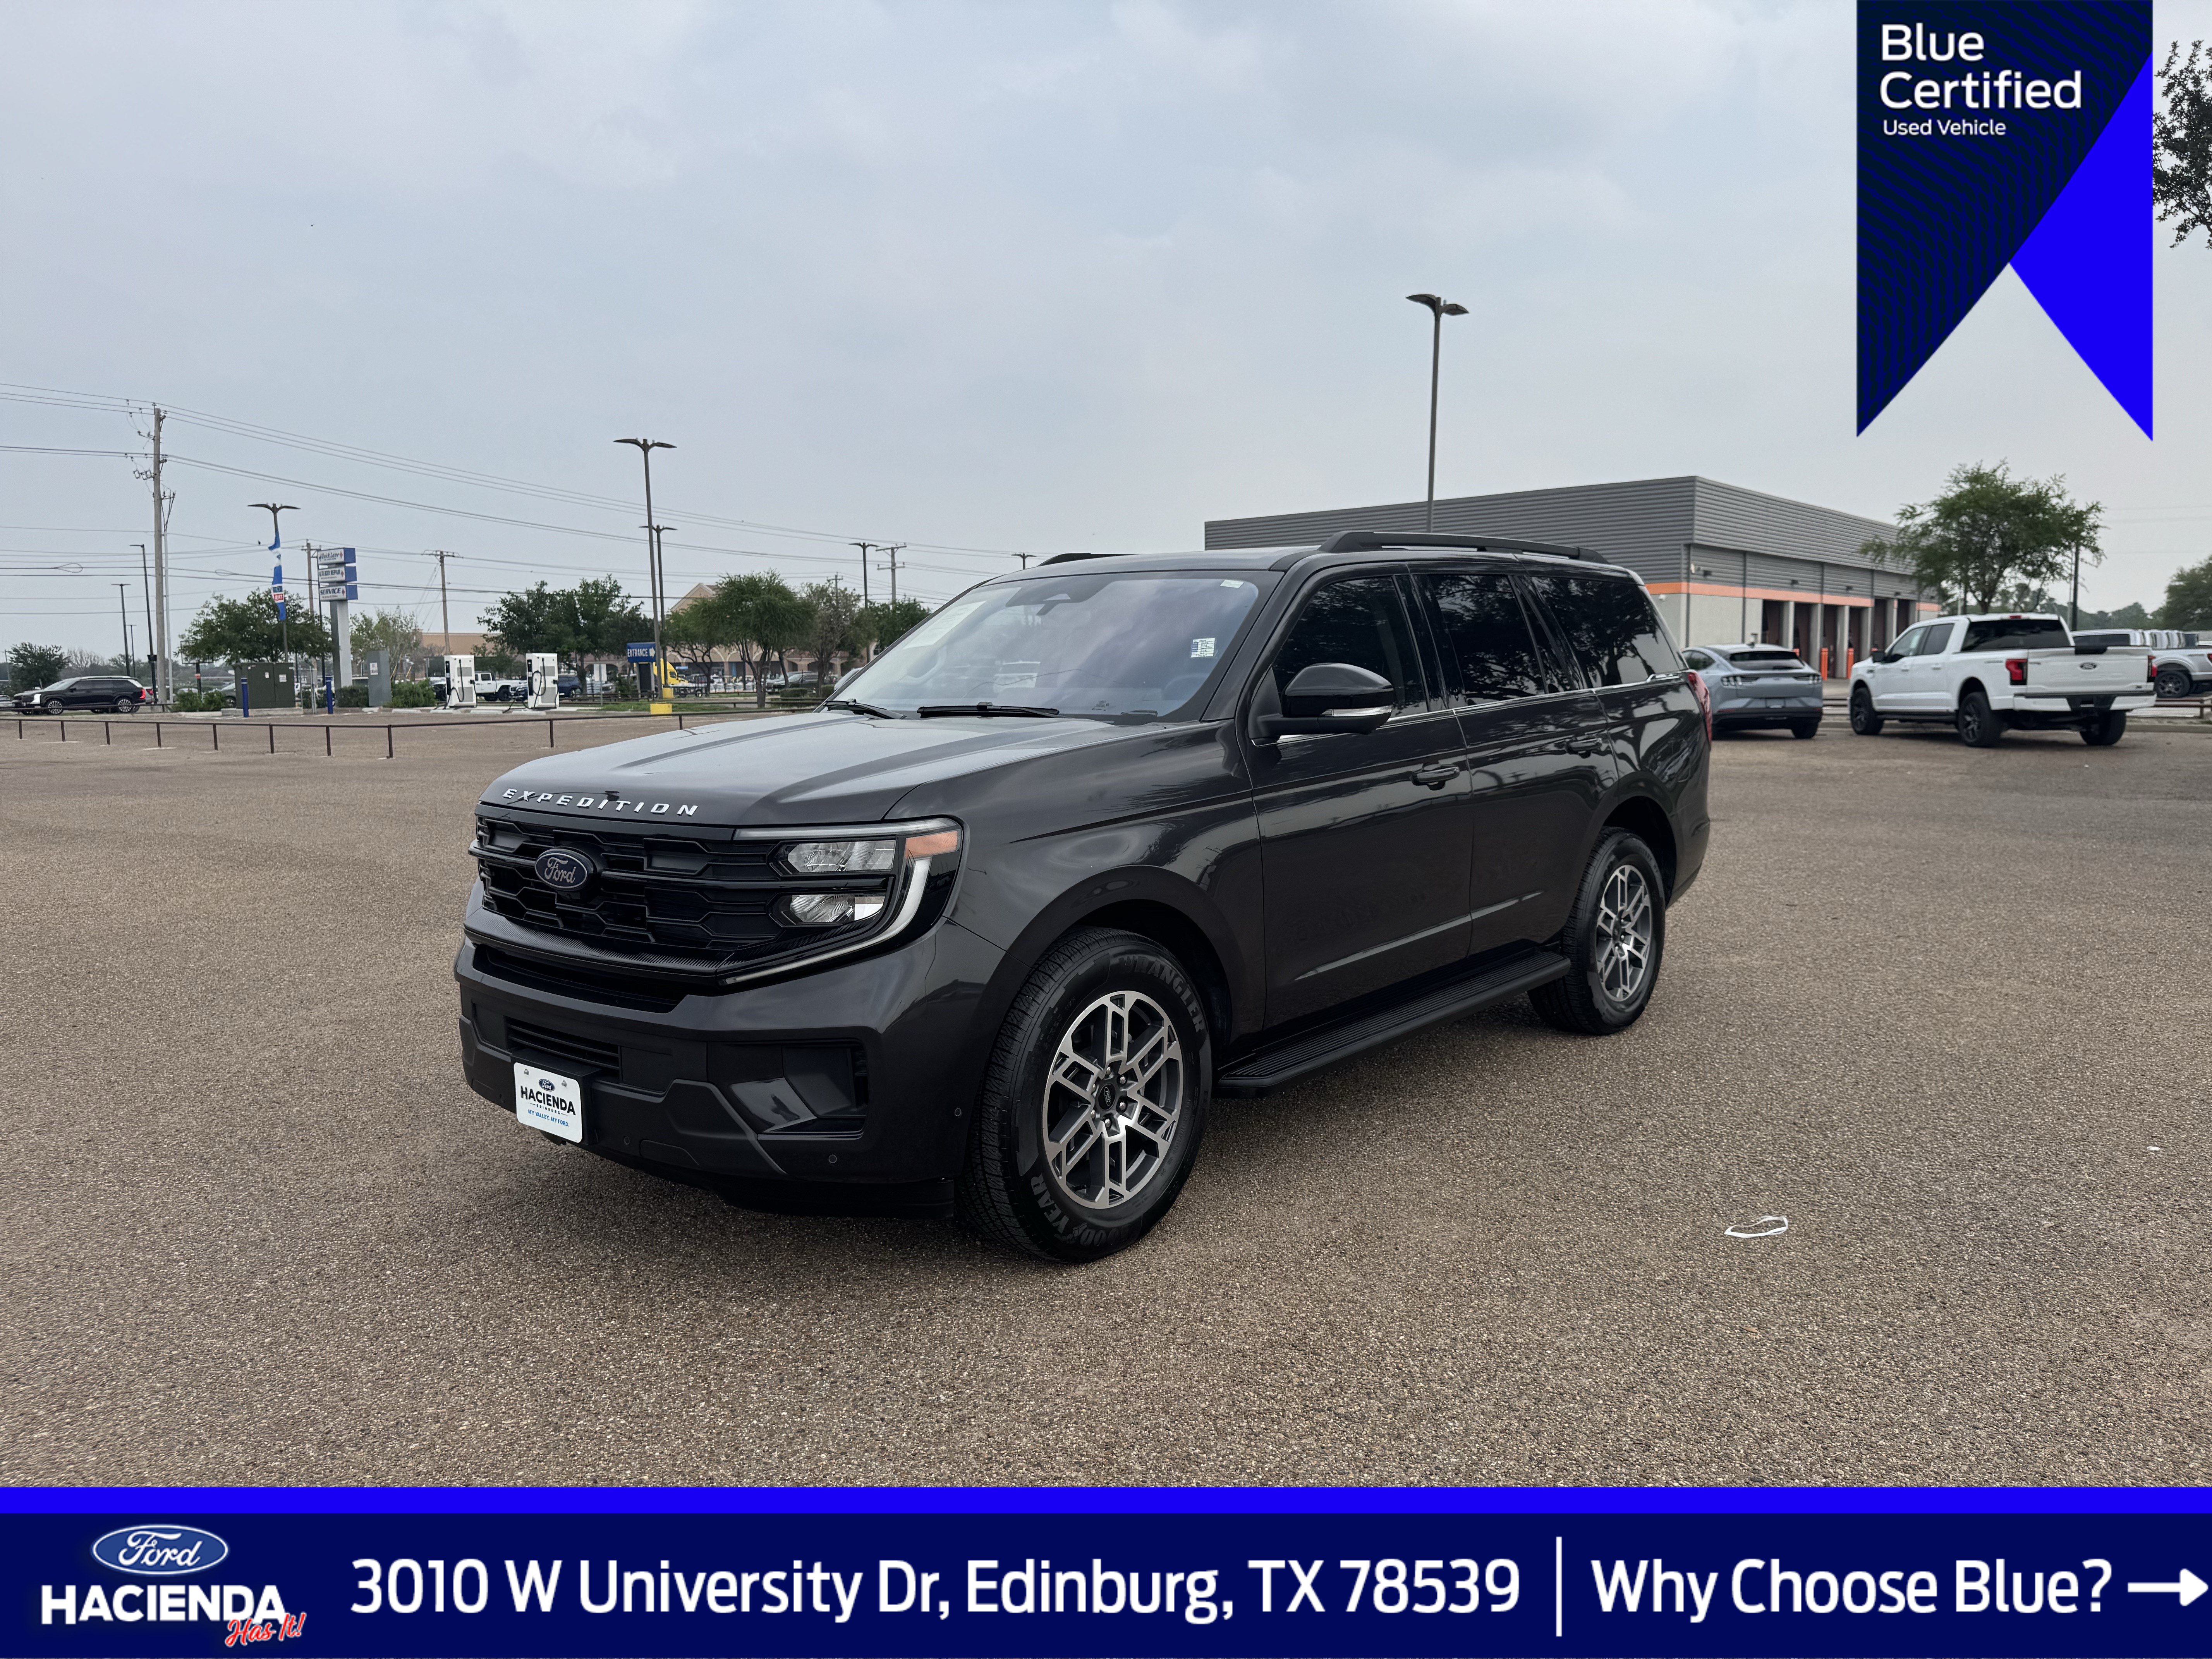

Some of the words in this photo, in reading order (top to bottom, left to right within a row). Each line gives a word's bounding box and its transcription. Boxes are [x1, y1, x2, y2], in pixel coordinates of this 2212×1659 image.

[627, 648, 648, 657] ENTRANCE
[502, 788, 698, 816] EXPEDITION
[544, 857, 577, 883] Ford
[1118, 955, 1205, 1033] WRANGLER
[520, 1085, 576, 1115] HACIENDA
